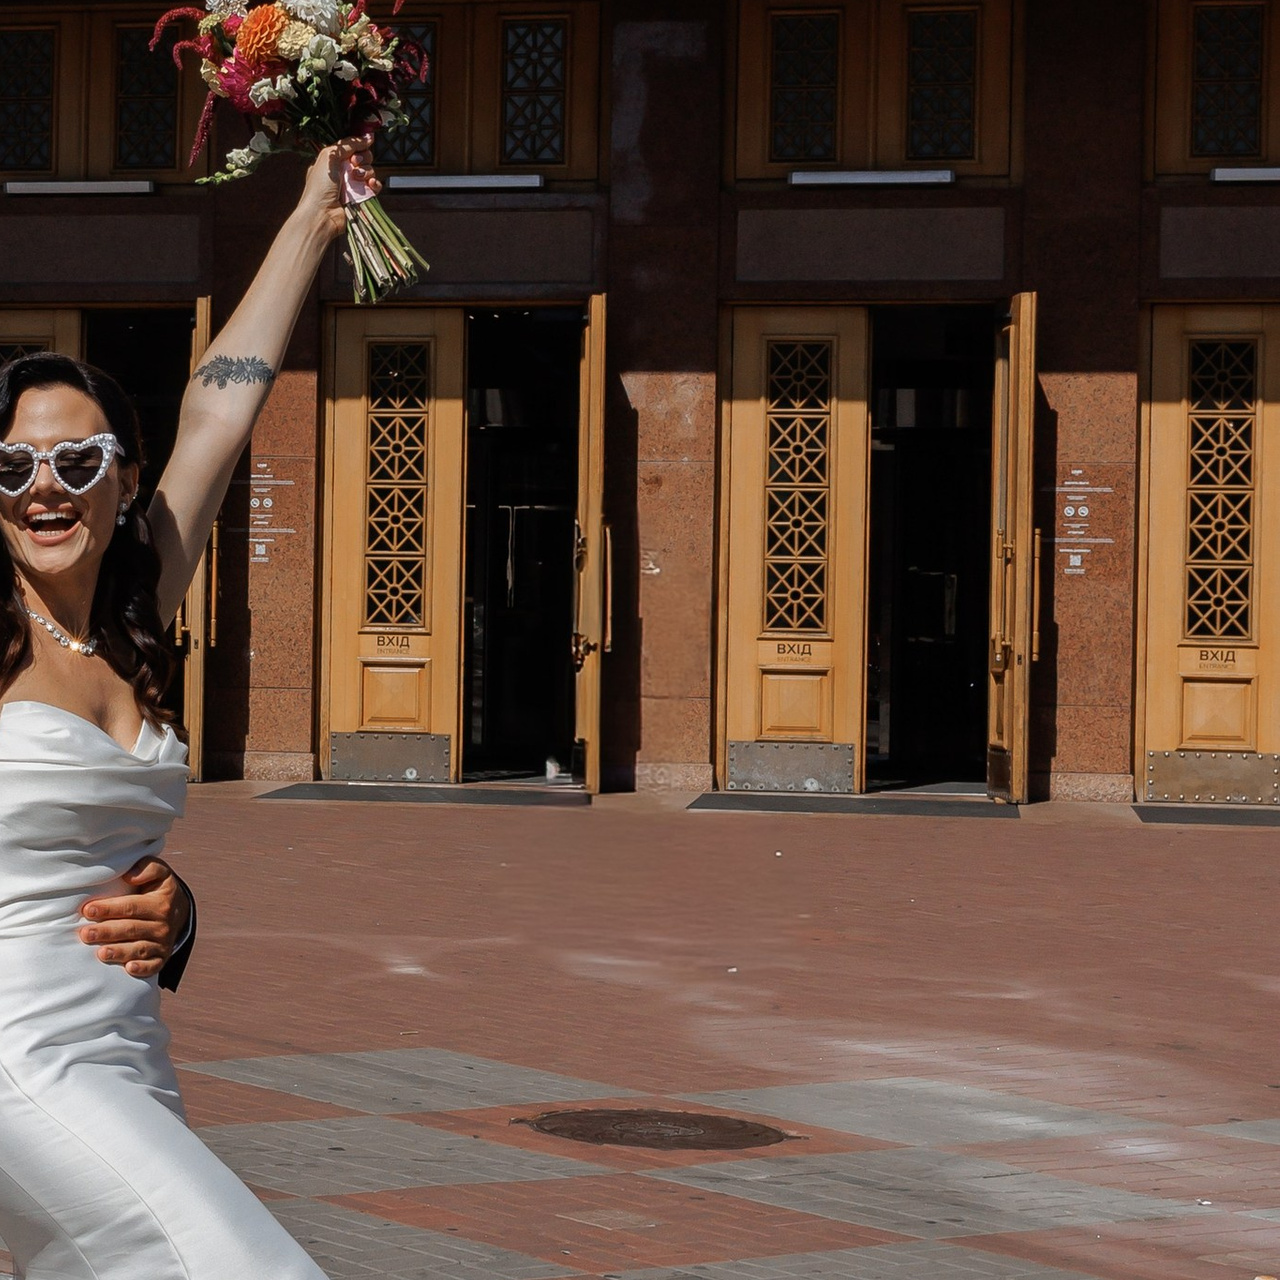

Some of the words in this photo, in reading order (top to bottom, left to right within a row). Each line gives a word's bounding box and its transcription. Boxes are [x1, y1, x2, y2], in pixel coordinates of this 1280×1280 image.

[377, 635, 410, 648] ВХІД
[777, 643, 812, 656] ВХІД
[1199, 650, 1236, 663] ВХІД
